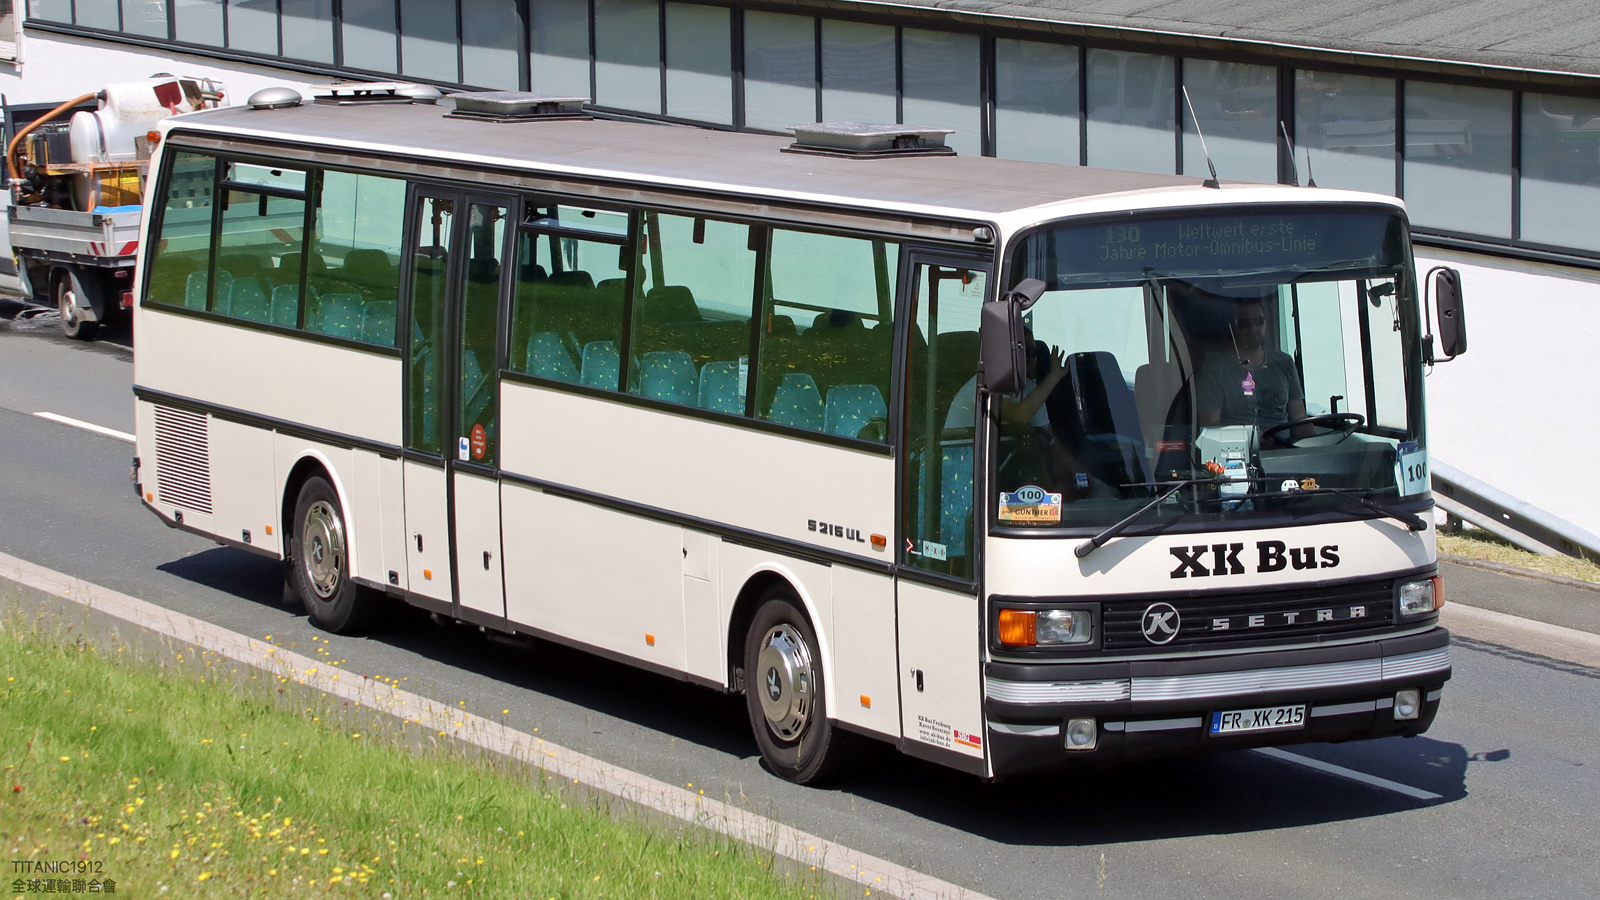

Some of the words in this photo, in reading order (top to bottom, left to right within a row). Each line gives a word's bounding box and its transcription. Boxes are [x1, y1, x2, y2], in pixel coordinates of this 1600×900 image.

[1106, 226, 1140, 243] 130
[1179, 221, 1244, 239] Weltweit
[1251, 219, 1295, 236] erste
[1100, 244, 1147, 261] Jahre
[1155, 234, 1317, 258] Motor-Omnibus-Linie
[1020, 490, 1042, 500] 100
[1015, 507, 1049, 516] GÜNTHER
[807, 519, 817, 532] S
[819, 521, 844, 538] 215
[846, 527, 866, 543] UL
[1169, 542, 1246, 579] XK
[1256, 540, 1341, 573] Bus
[1212, 606, 1366, 631] SETRA
[1221, 712, 1242, 730] FR
[1252, 709, 1273, 728] XK
[1275, 707, 1304, 725] 215
